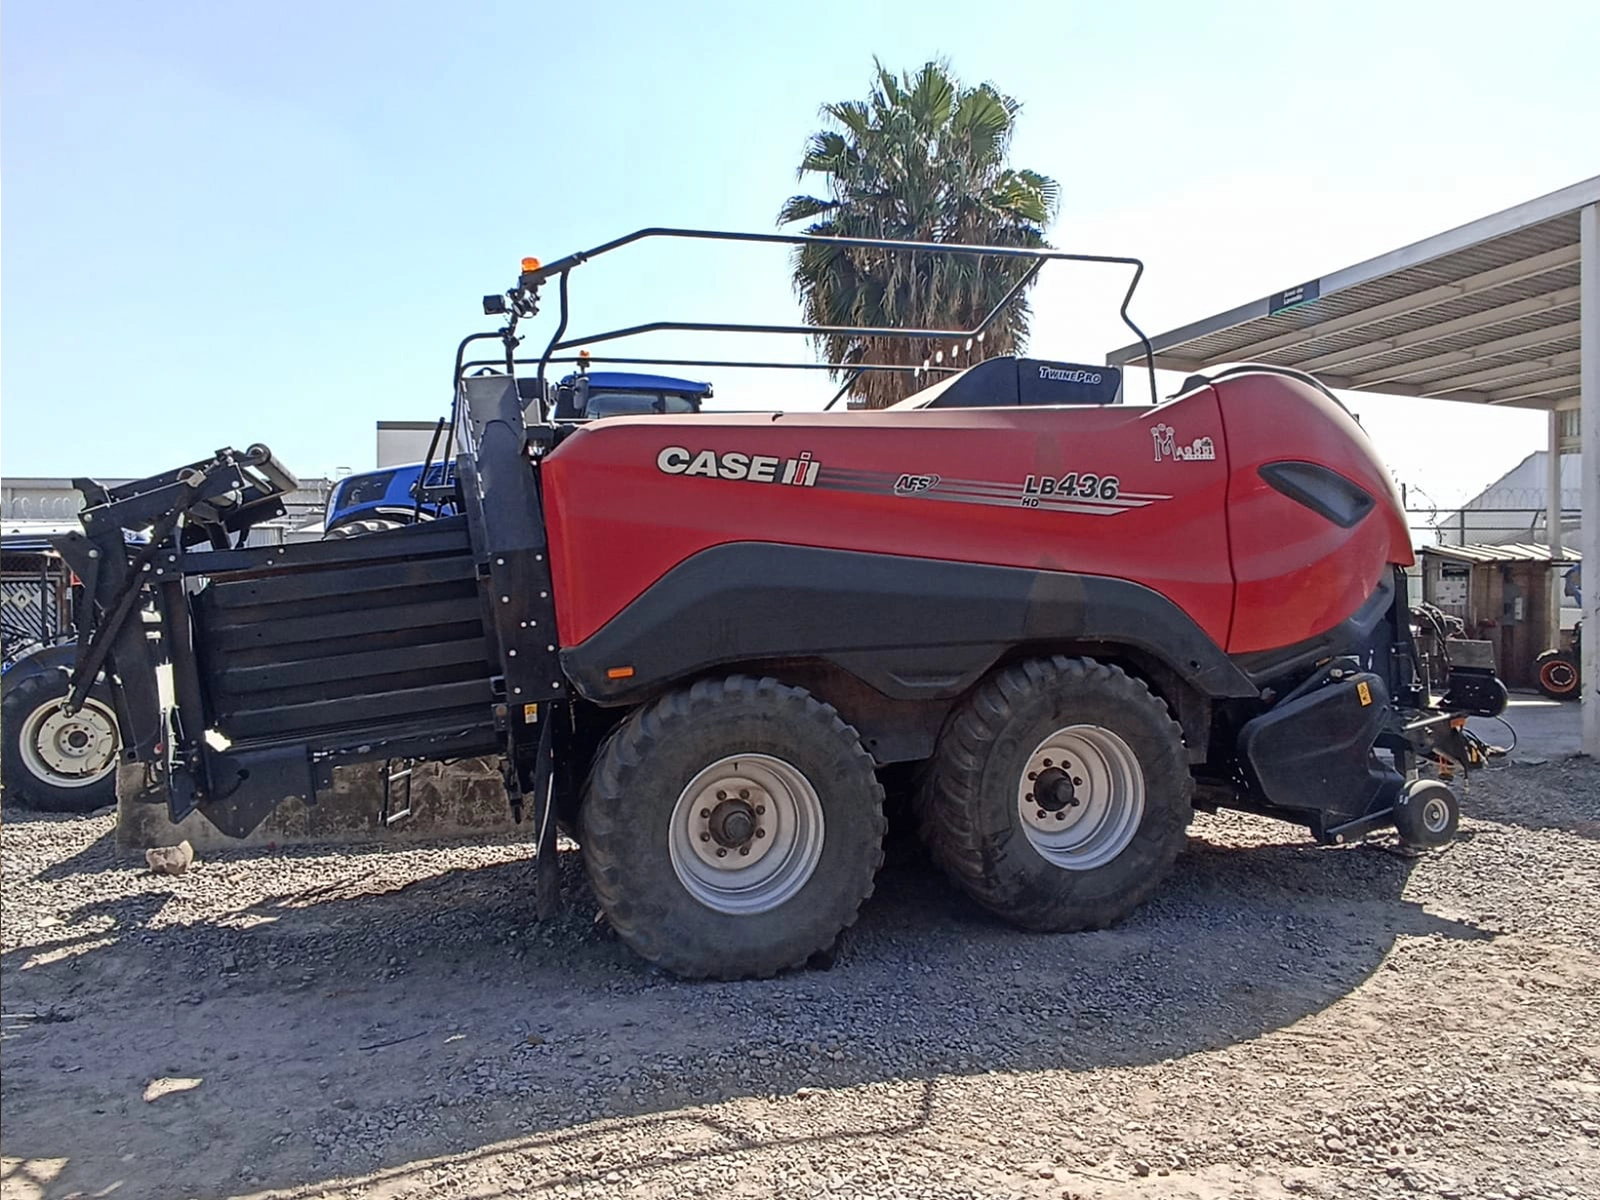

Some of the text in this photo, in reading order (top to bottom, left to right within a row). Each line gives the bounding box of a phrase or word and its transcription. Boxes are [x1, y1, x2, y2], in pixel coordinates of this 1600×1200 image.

[657, 446, 779, 482] CASE
[894, 474, 930, 491] AFS
[1023, 472, 1119, 502] LB436
[1021, 496, 1040, 508] HD
